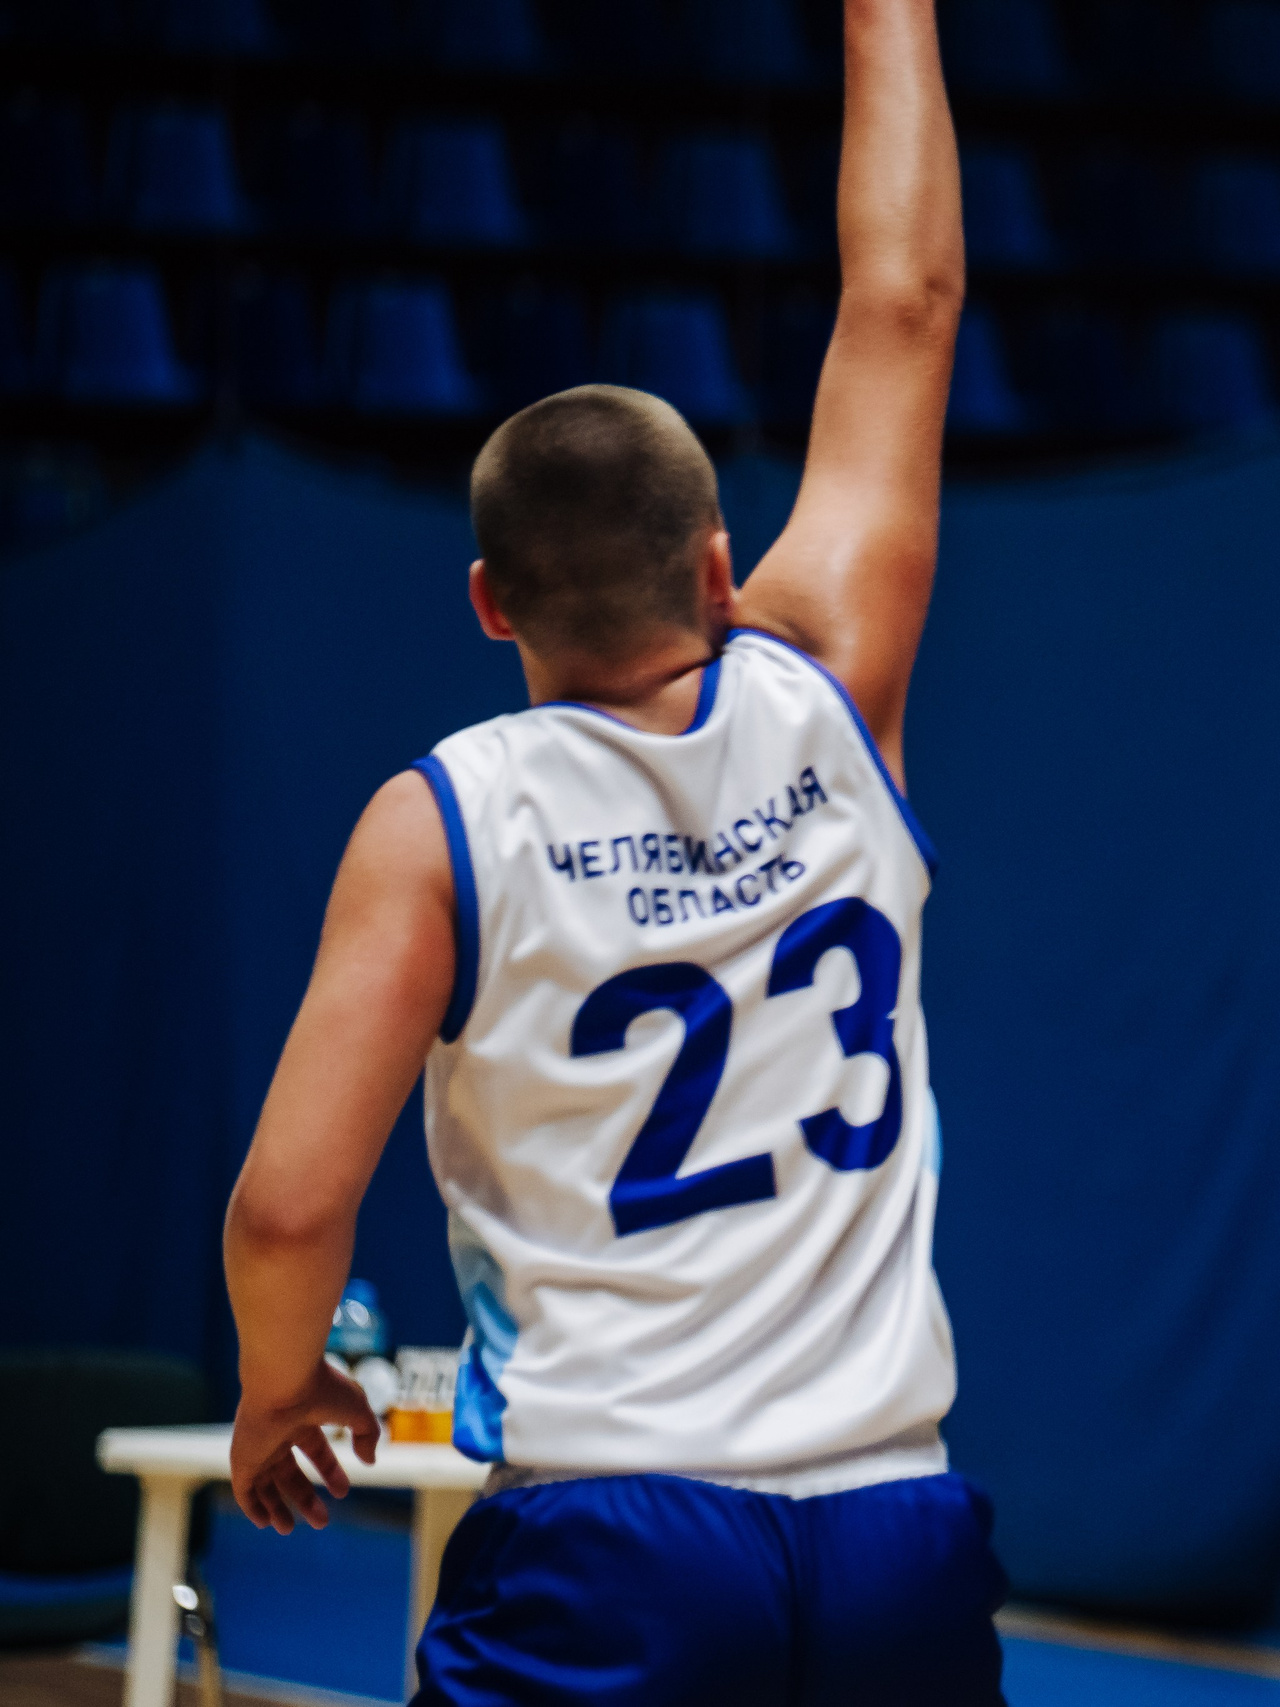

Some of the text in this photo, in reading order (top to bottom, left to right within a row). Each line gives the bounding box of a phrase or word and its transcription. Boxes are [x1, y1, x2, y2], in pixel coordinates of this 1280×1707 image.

[548, 766, 828, 882] ЧЕЛЯБИНСКАЯ
[626, 854, 807, 926] ОБЛАСТЬ
[570, 896, 902, 1238] 23
